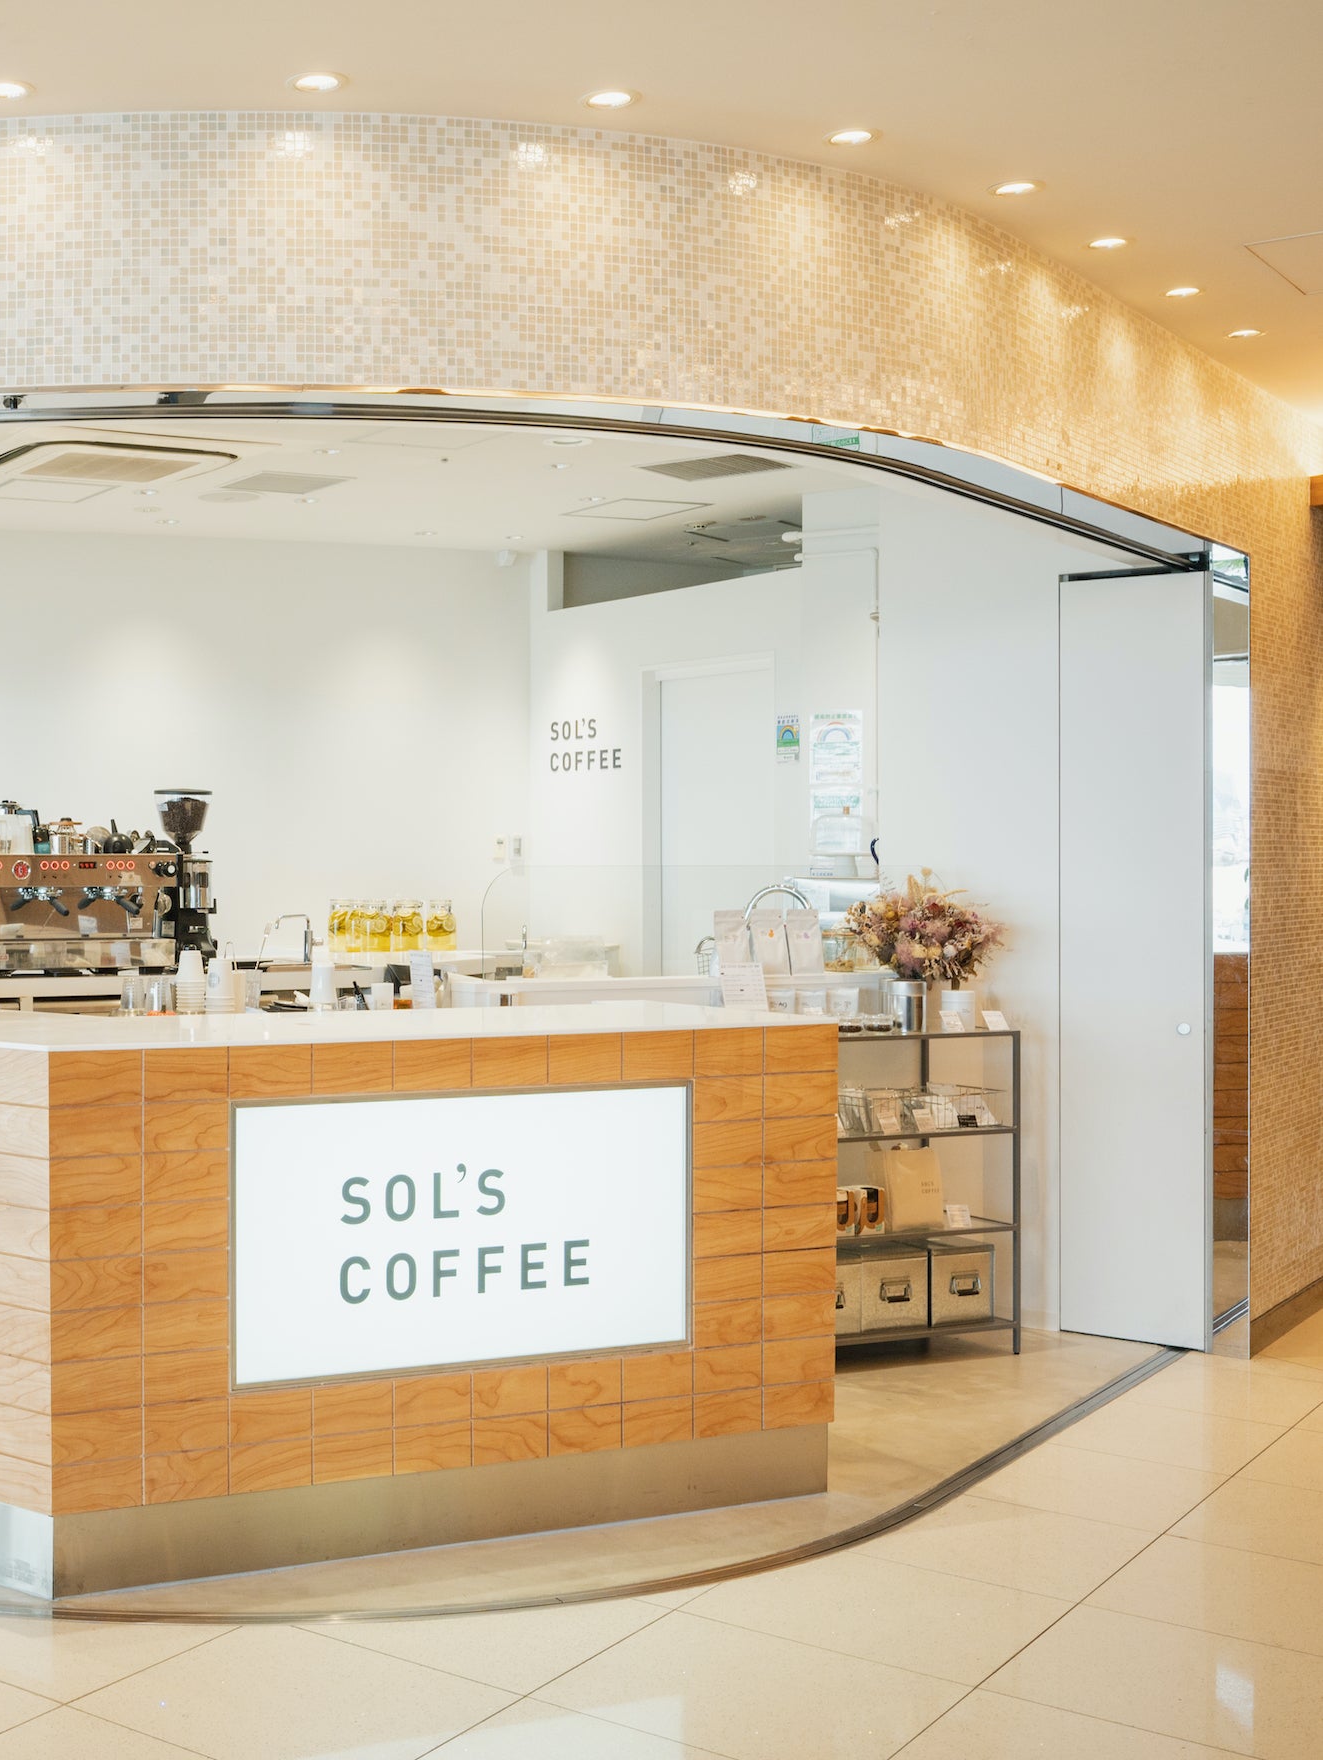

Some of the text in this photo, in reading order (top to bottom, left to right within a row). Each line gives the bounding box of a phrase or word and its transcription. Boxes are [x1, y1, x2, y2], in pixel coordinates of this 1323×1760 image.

[550, 718, 597, 741] SOL'S
[550, 748, 622, 772] COFFEE
[339, 1163, 507, 1226] SOL'S
[339, 1239, 590, 1305] COFFEE
